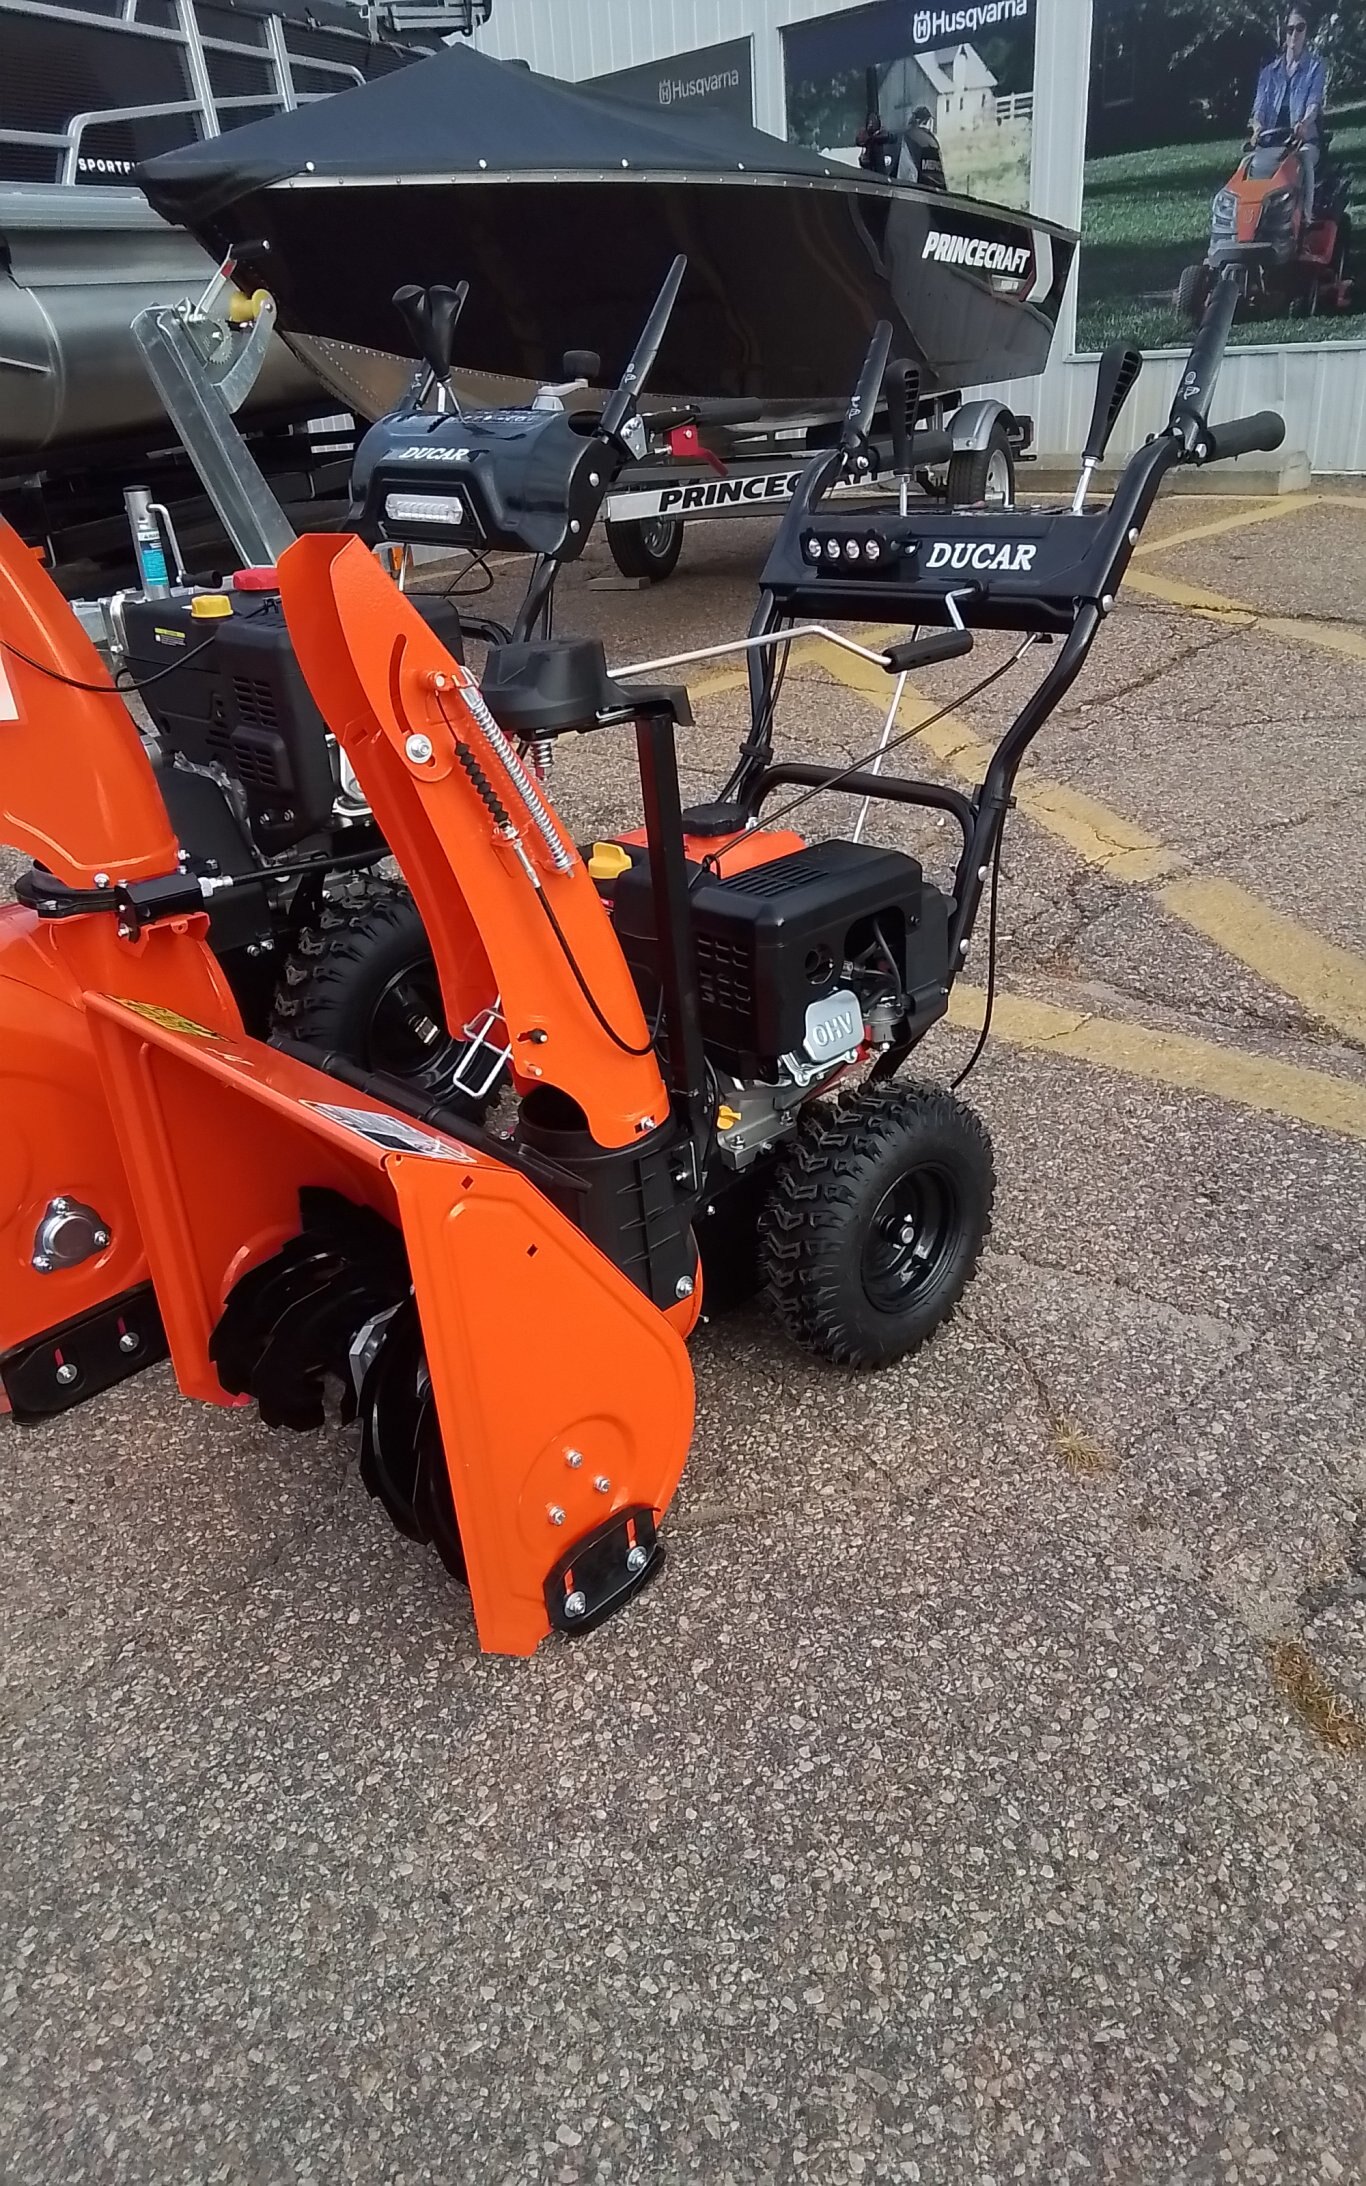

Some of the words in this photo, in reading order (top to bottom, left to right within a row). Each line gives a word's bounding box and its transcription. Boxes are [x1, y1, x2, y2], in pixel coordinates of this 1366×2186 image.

[932, 0, 1027, 36] Husqvarna
[672, 69, 739, 100] Husqvarna
[921, 230, 1031, 273] PRINCECRAFT
[398, 446, 470, 461] DUCAR
[925, 542, 1037, 570] DUCAR
[812, 1011, 854, 1047] OHV
